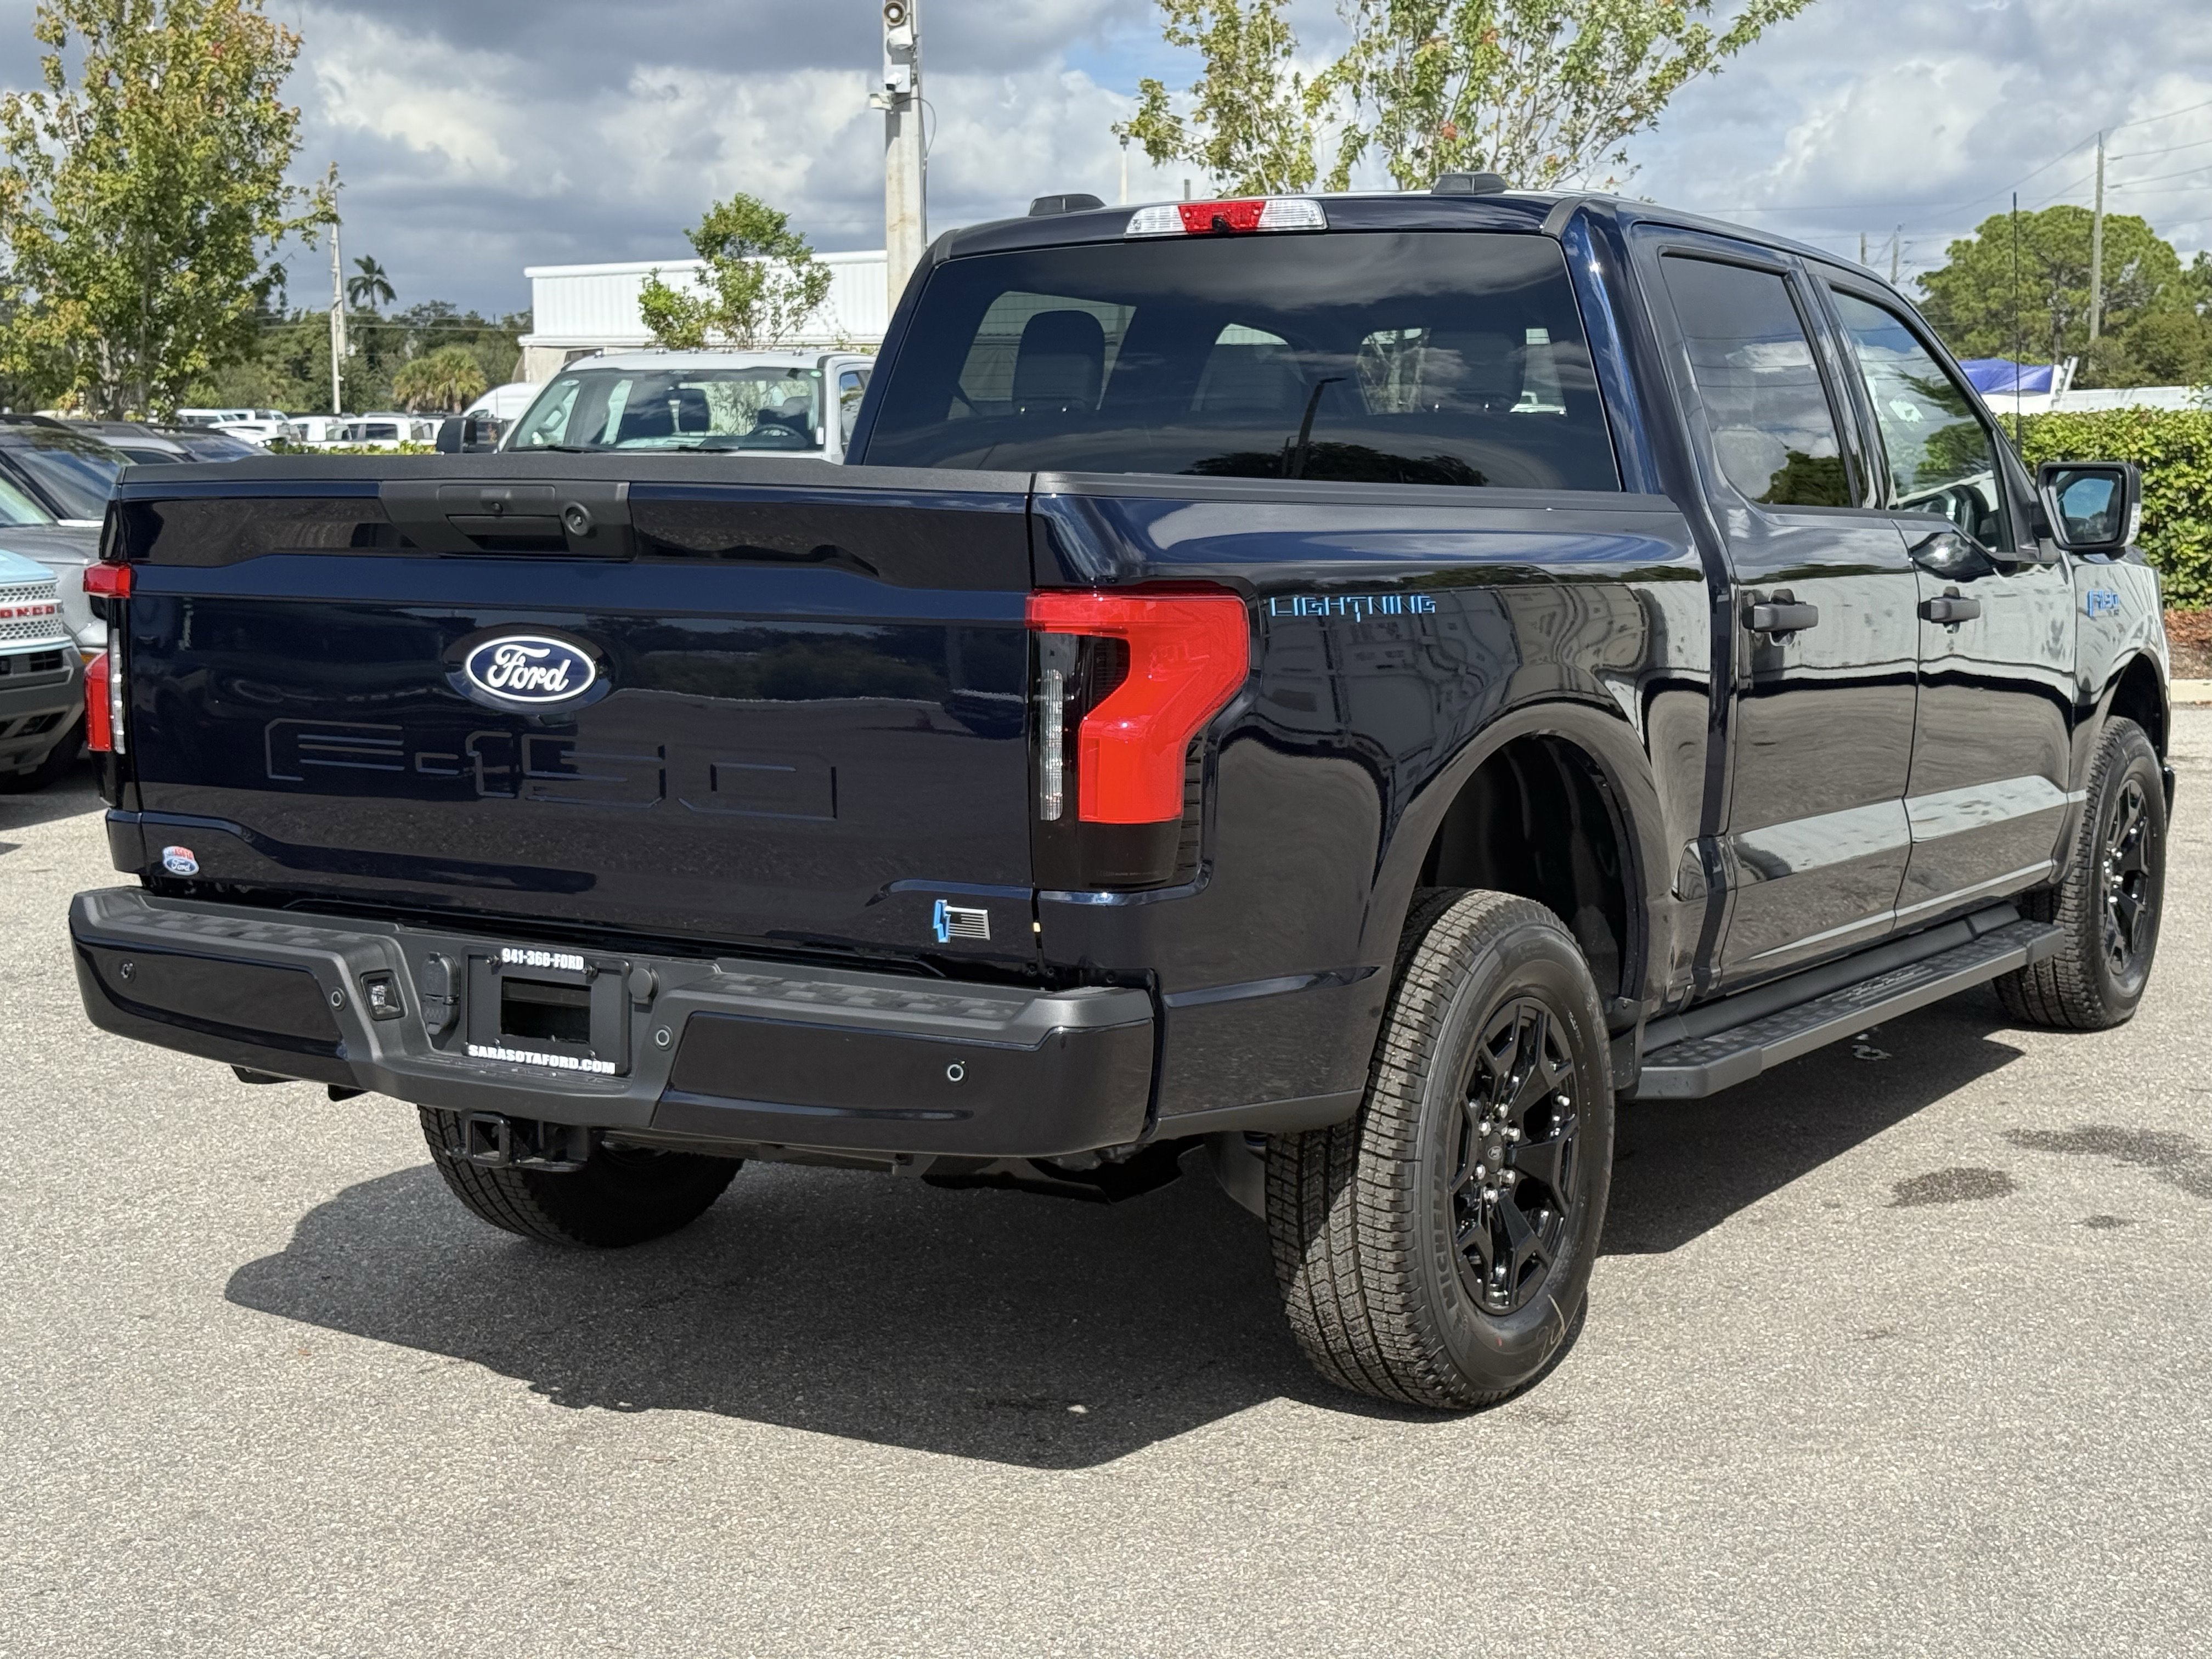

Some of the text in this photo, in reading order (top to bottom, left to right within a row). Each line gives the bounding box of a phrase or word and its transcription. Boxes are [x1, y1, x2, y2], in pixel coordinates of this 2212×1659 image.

[1269, 596, 1436, 623] LIGHTNING
[487, 644, 572, 692] Ford
[265, 718, 838, 822] F-150
[171, 859, 191, 872] Ford
[501, 947, 584, 970] 941-366-FORD
[469, 1044, 616, 1074] SARASOTAFORD.COM
